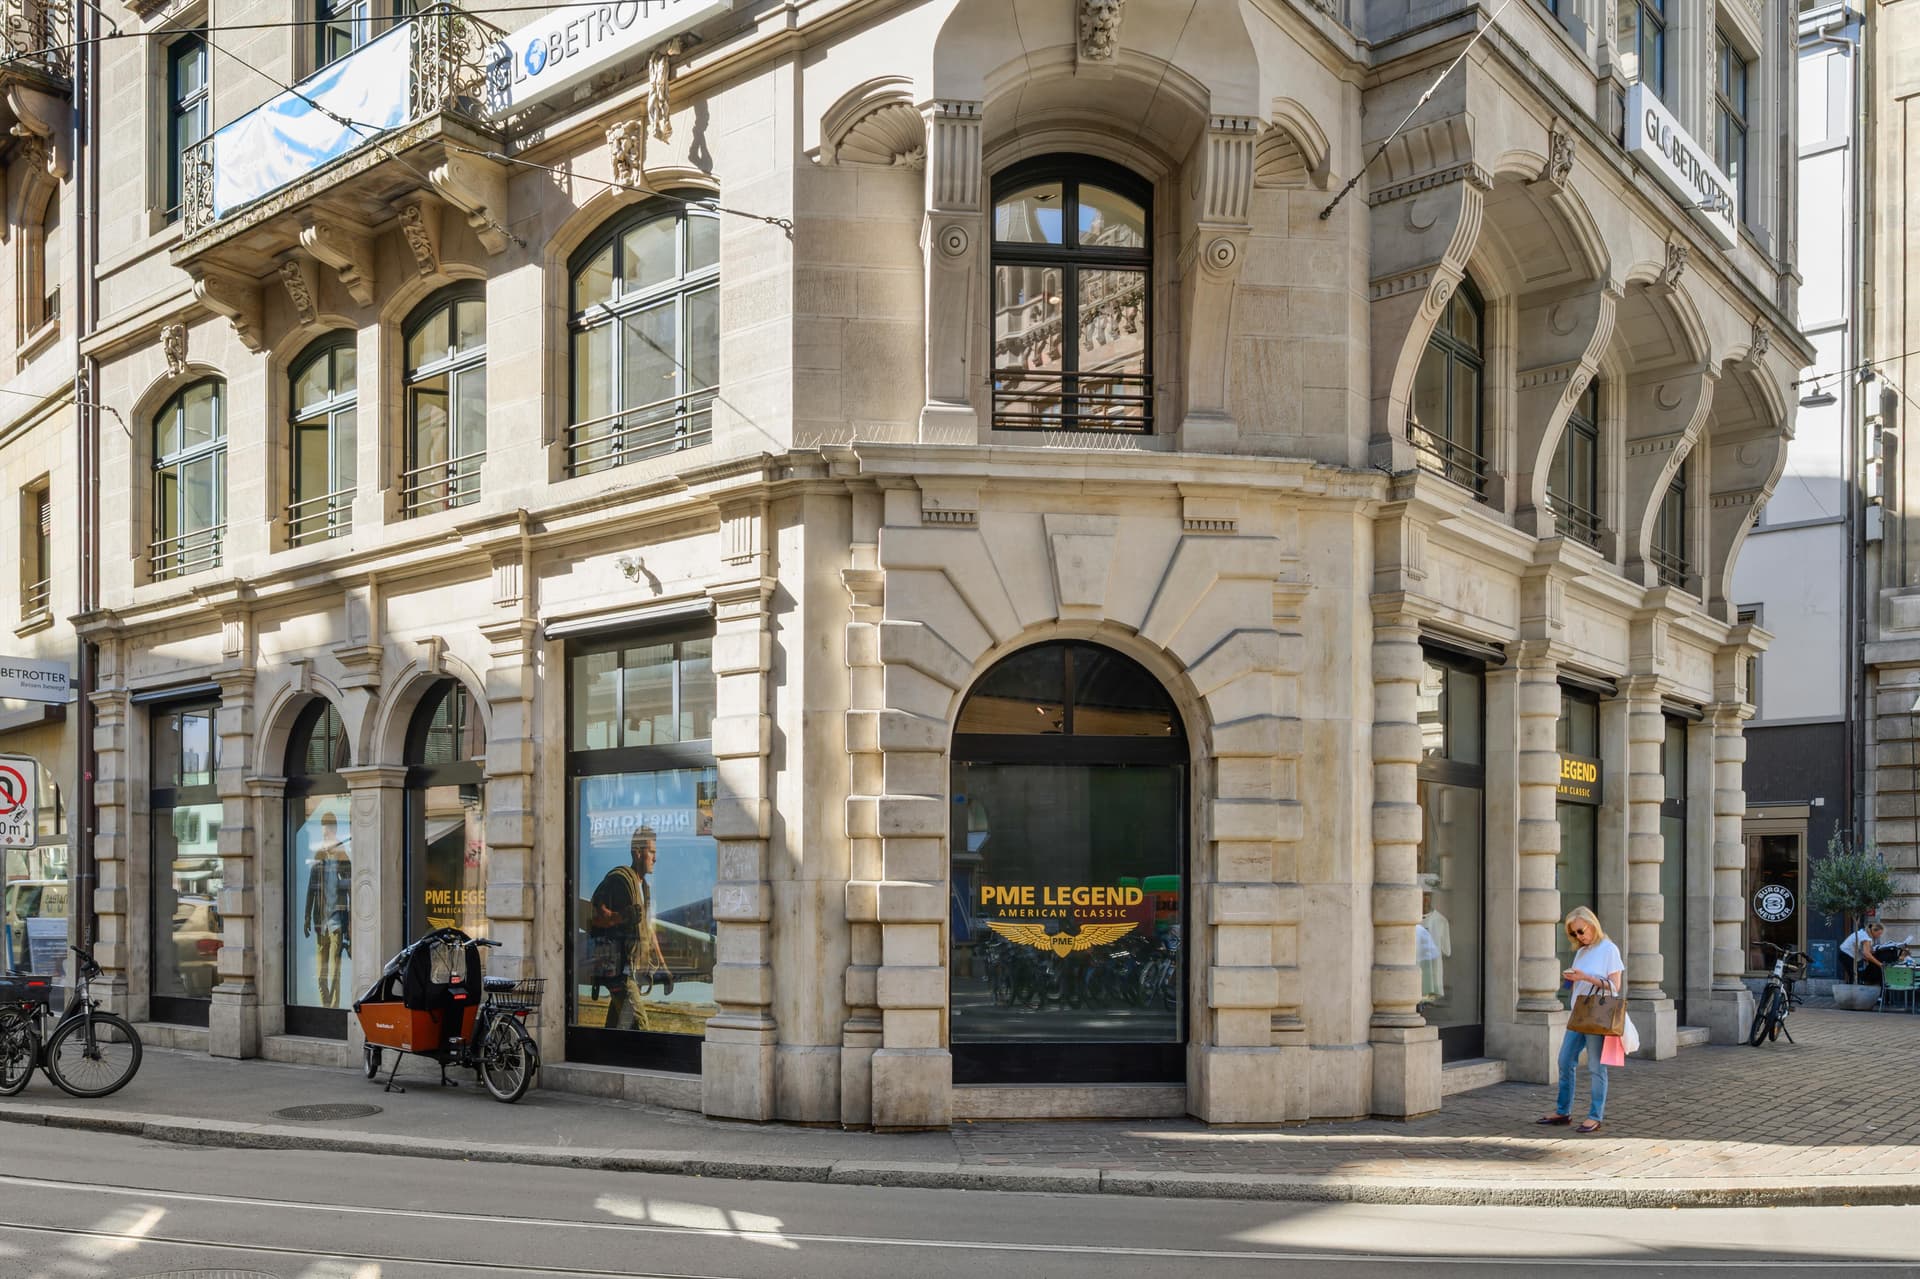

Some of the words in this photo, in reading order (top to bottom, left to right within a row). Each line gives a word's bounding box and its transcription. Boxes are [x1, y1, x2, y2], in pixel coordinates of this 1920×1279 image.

[1570, 786, 1592, 798] CLASSIC
[425, 889, 451, 905] PME
[981, 885, 1035, 906] PME
[1043, 885, 1143, 906] LEGEND
[1757, 886, 1790, 900] BURGER
[999, 908, 1067, 918] AMERICAN
[1074, 908, 1127, 918] CLASSIC
[1757, 906, 1791, 920] MEISTER
[1052, 937, 1073, 946] PME
